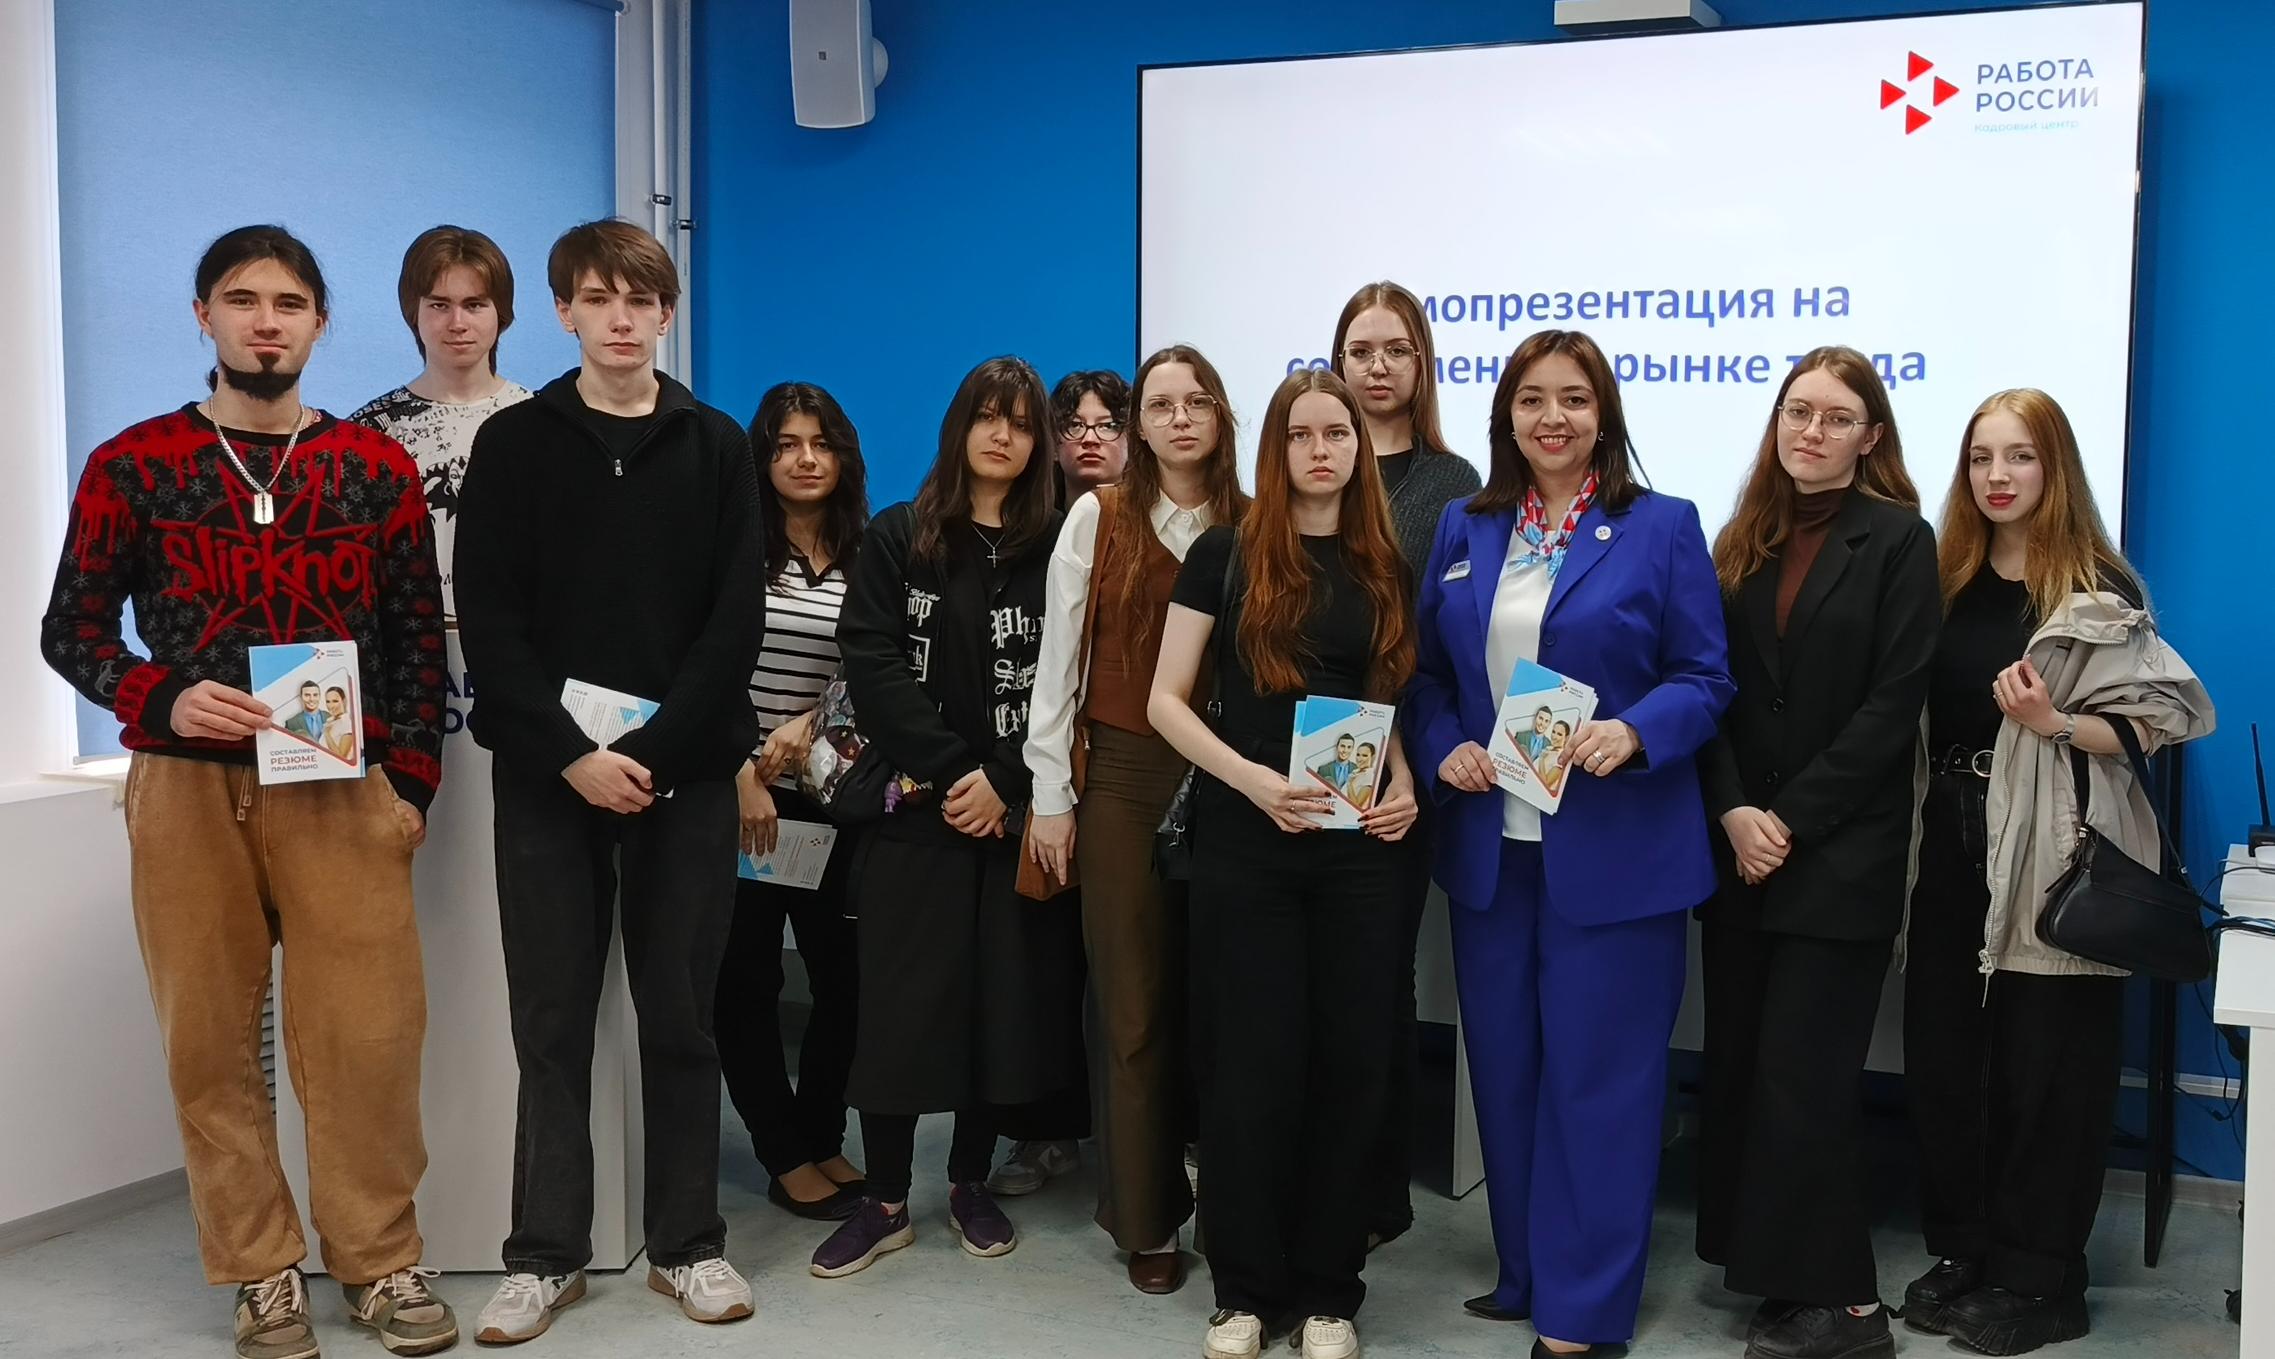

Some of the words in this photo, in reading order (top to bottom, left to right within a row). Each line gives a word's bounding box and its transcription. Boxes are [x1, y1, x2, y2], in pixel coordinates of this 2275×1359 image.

[1976, 58, 2095, 85] РАБОТА
[1975, 86, 2100, 113] РОССИИ
[1793, 286, 1850, 318] на
[1614, 352, 1770, 388] рынке
[270, 755, 318, 765] РЕЗЮМЕ
